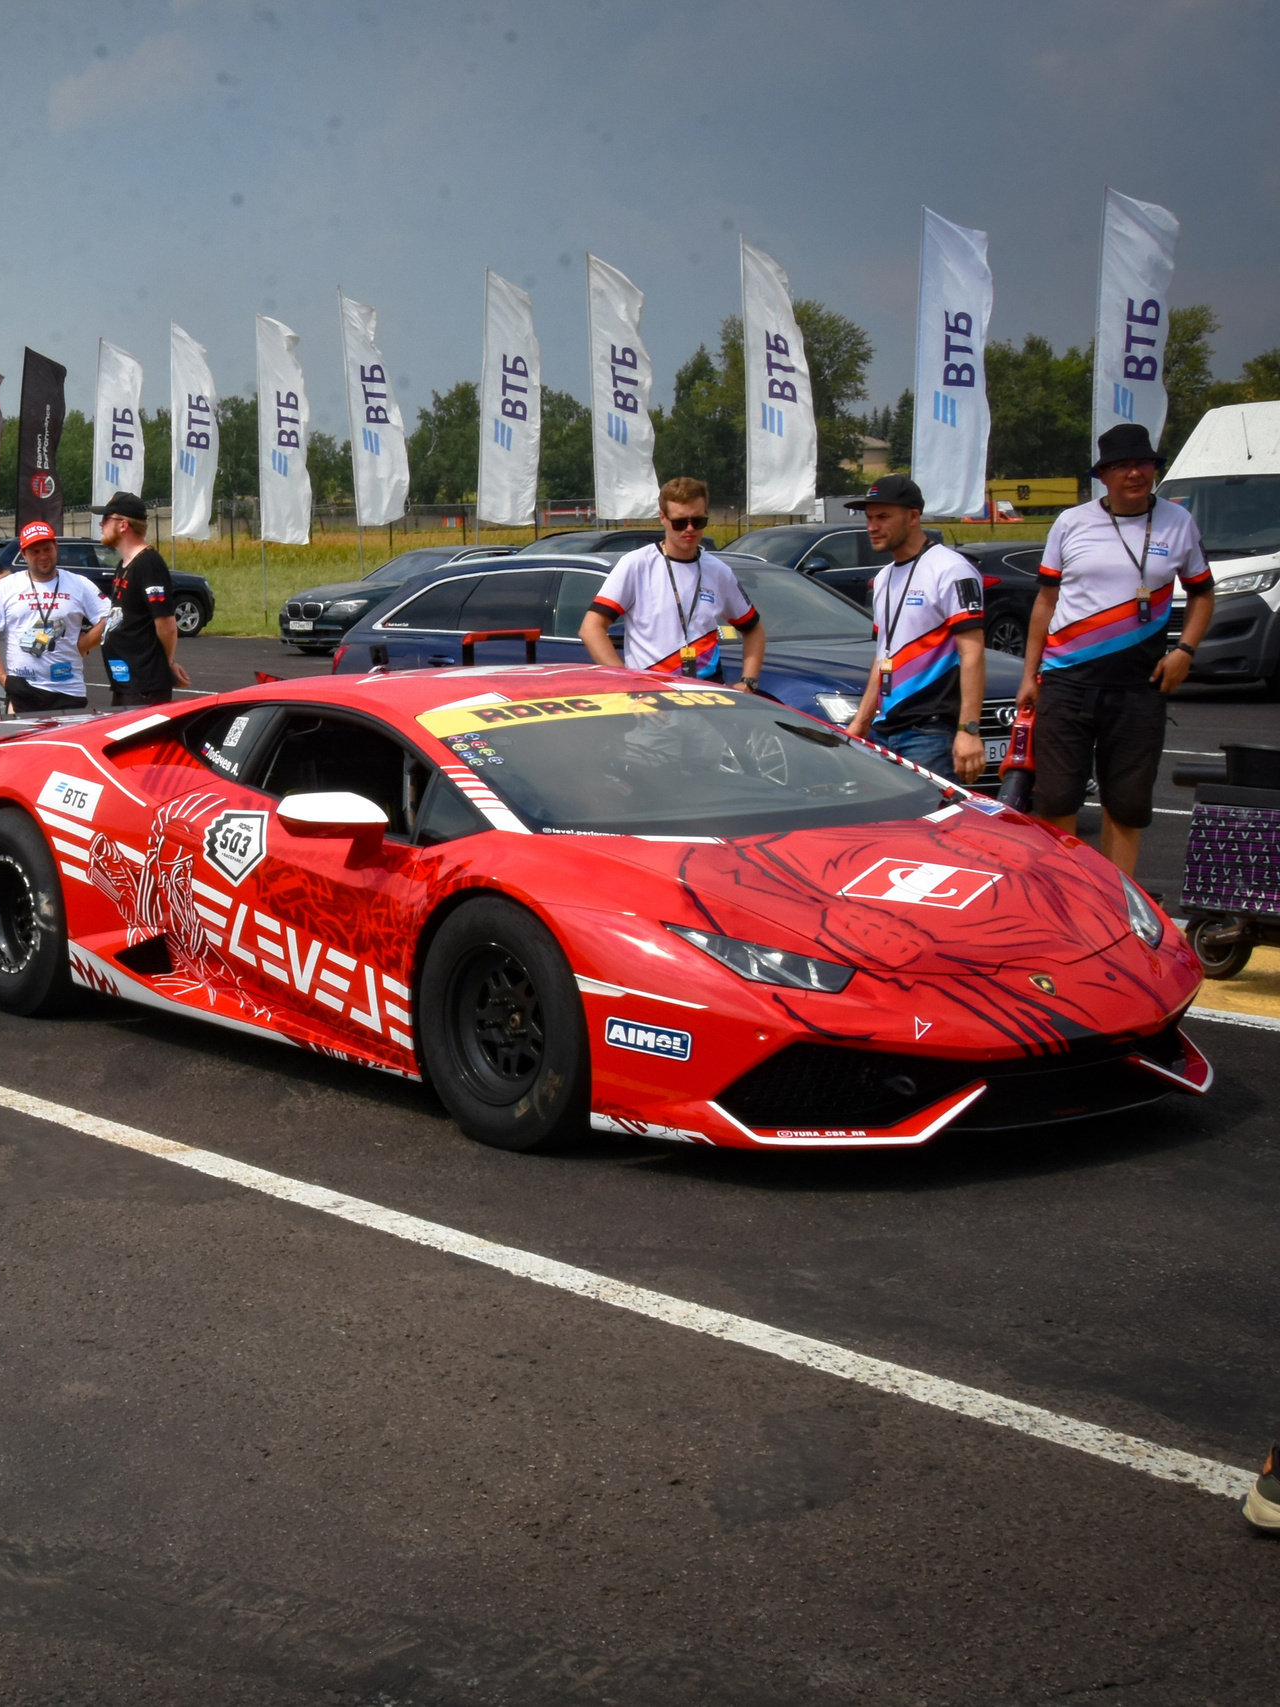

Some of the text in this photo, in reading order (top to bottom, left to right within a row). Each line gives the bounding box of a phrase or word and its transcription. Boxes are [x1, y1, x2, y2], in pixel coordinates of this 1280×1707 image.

[765, 330, 798, 403] ВТБ
[943, 310, 975, 388] ВТБ
[1124, 298, 1160, 381] ВТБ
[360, 363, 391, 424] ВТБ
[501, 354, 528, 421] ВТБ
[611, 344, 638, 414] ВТБ
[111, 407, 134, 461] ВТБ
[186, 393, 210, 450] ВТБ
[276, 390, 300, 448] ВТБ
[23, 525, 50, 537] LUKOIL
[18, 592, 70, 600] ATT RACE
[467, 698, 603, 723] RDRC
[206, 746, 232, 771] Лобачев
[62, 788, 89, 809] ВТБ
[219, 827, 252, 858] 503
[608, 1024, 686, 1055] AIMOL
